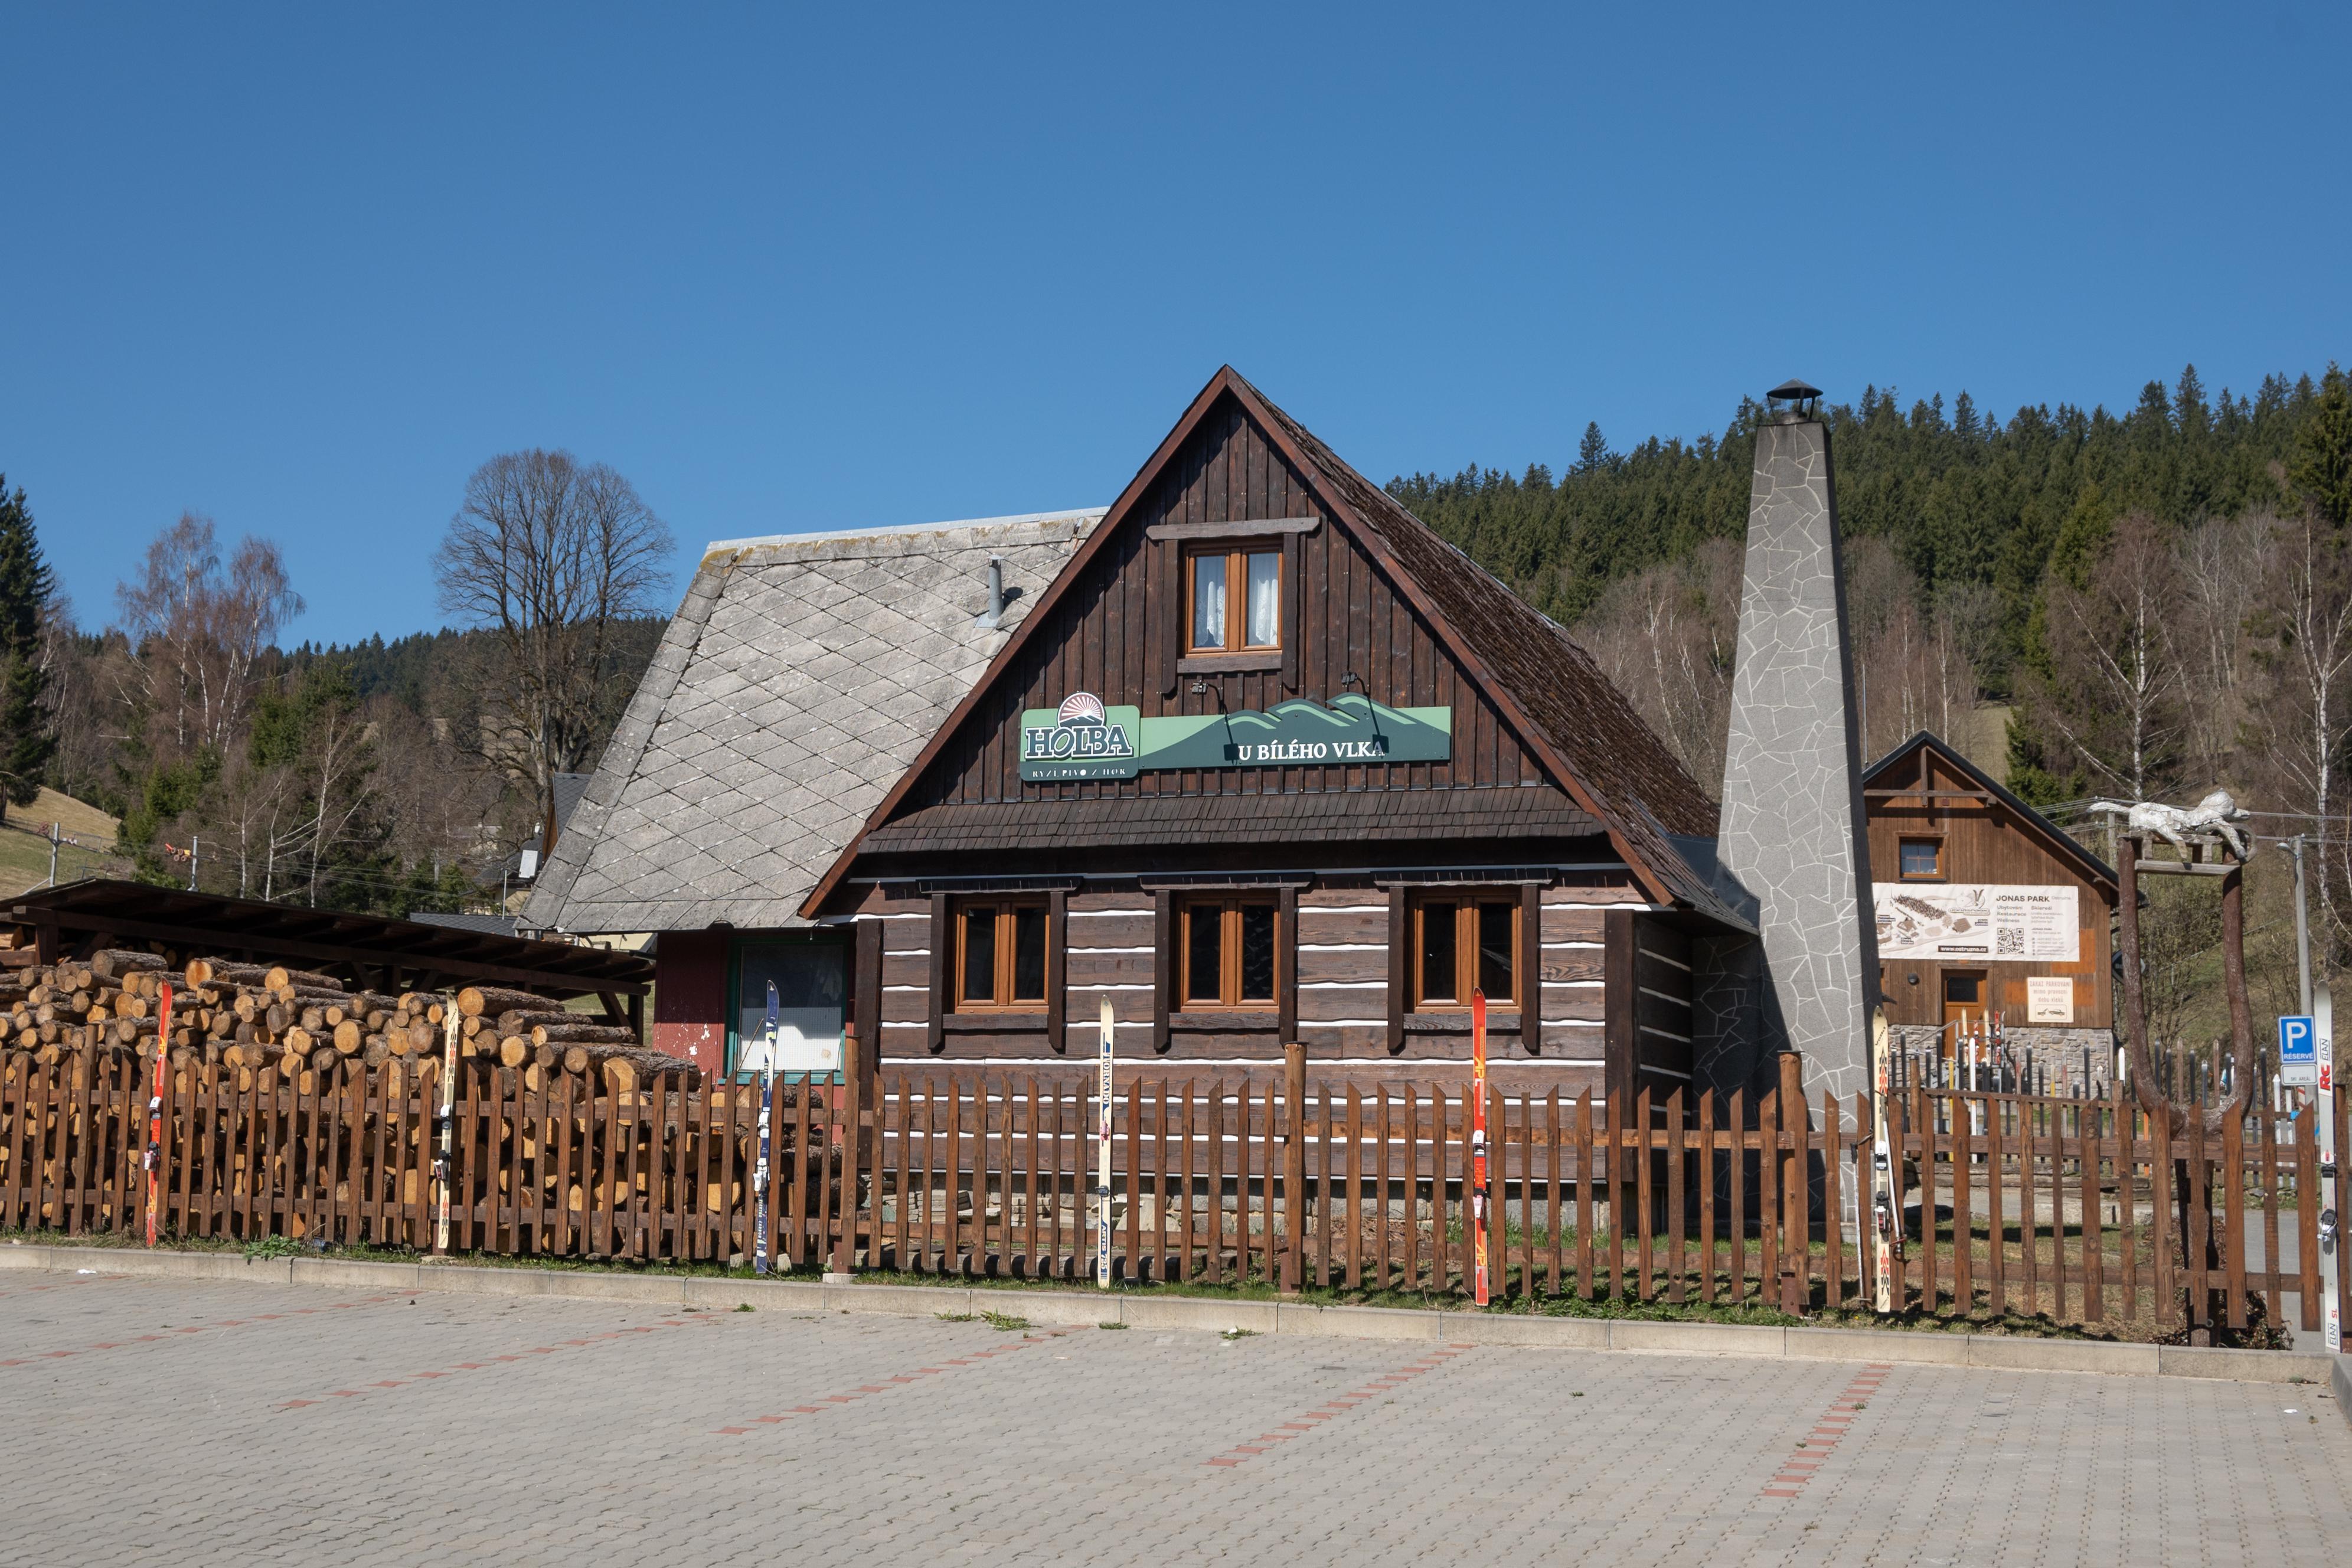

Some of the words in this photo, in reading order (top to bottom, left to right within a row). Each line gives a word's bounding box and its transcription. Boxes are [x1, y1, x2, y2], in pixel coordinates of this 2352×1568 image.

[1025, 724, 1133, 759] HOLBA
[1238, 746, 1252, 760] U
[1257, 739, 1327, 760] BÍLÉHO
[1332, 741, 1385, 757] VLKA
[2286, 1022, 2307, 1048] P
[1475, 1056, 1484, 1087] APL
[2320, 1063, 2330, 1091] RC
[1476, 1243, 1486, 1275] APL
[2331, 1309, 2338, 1319] SL
